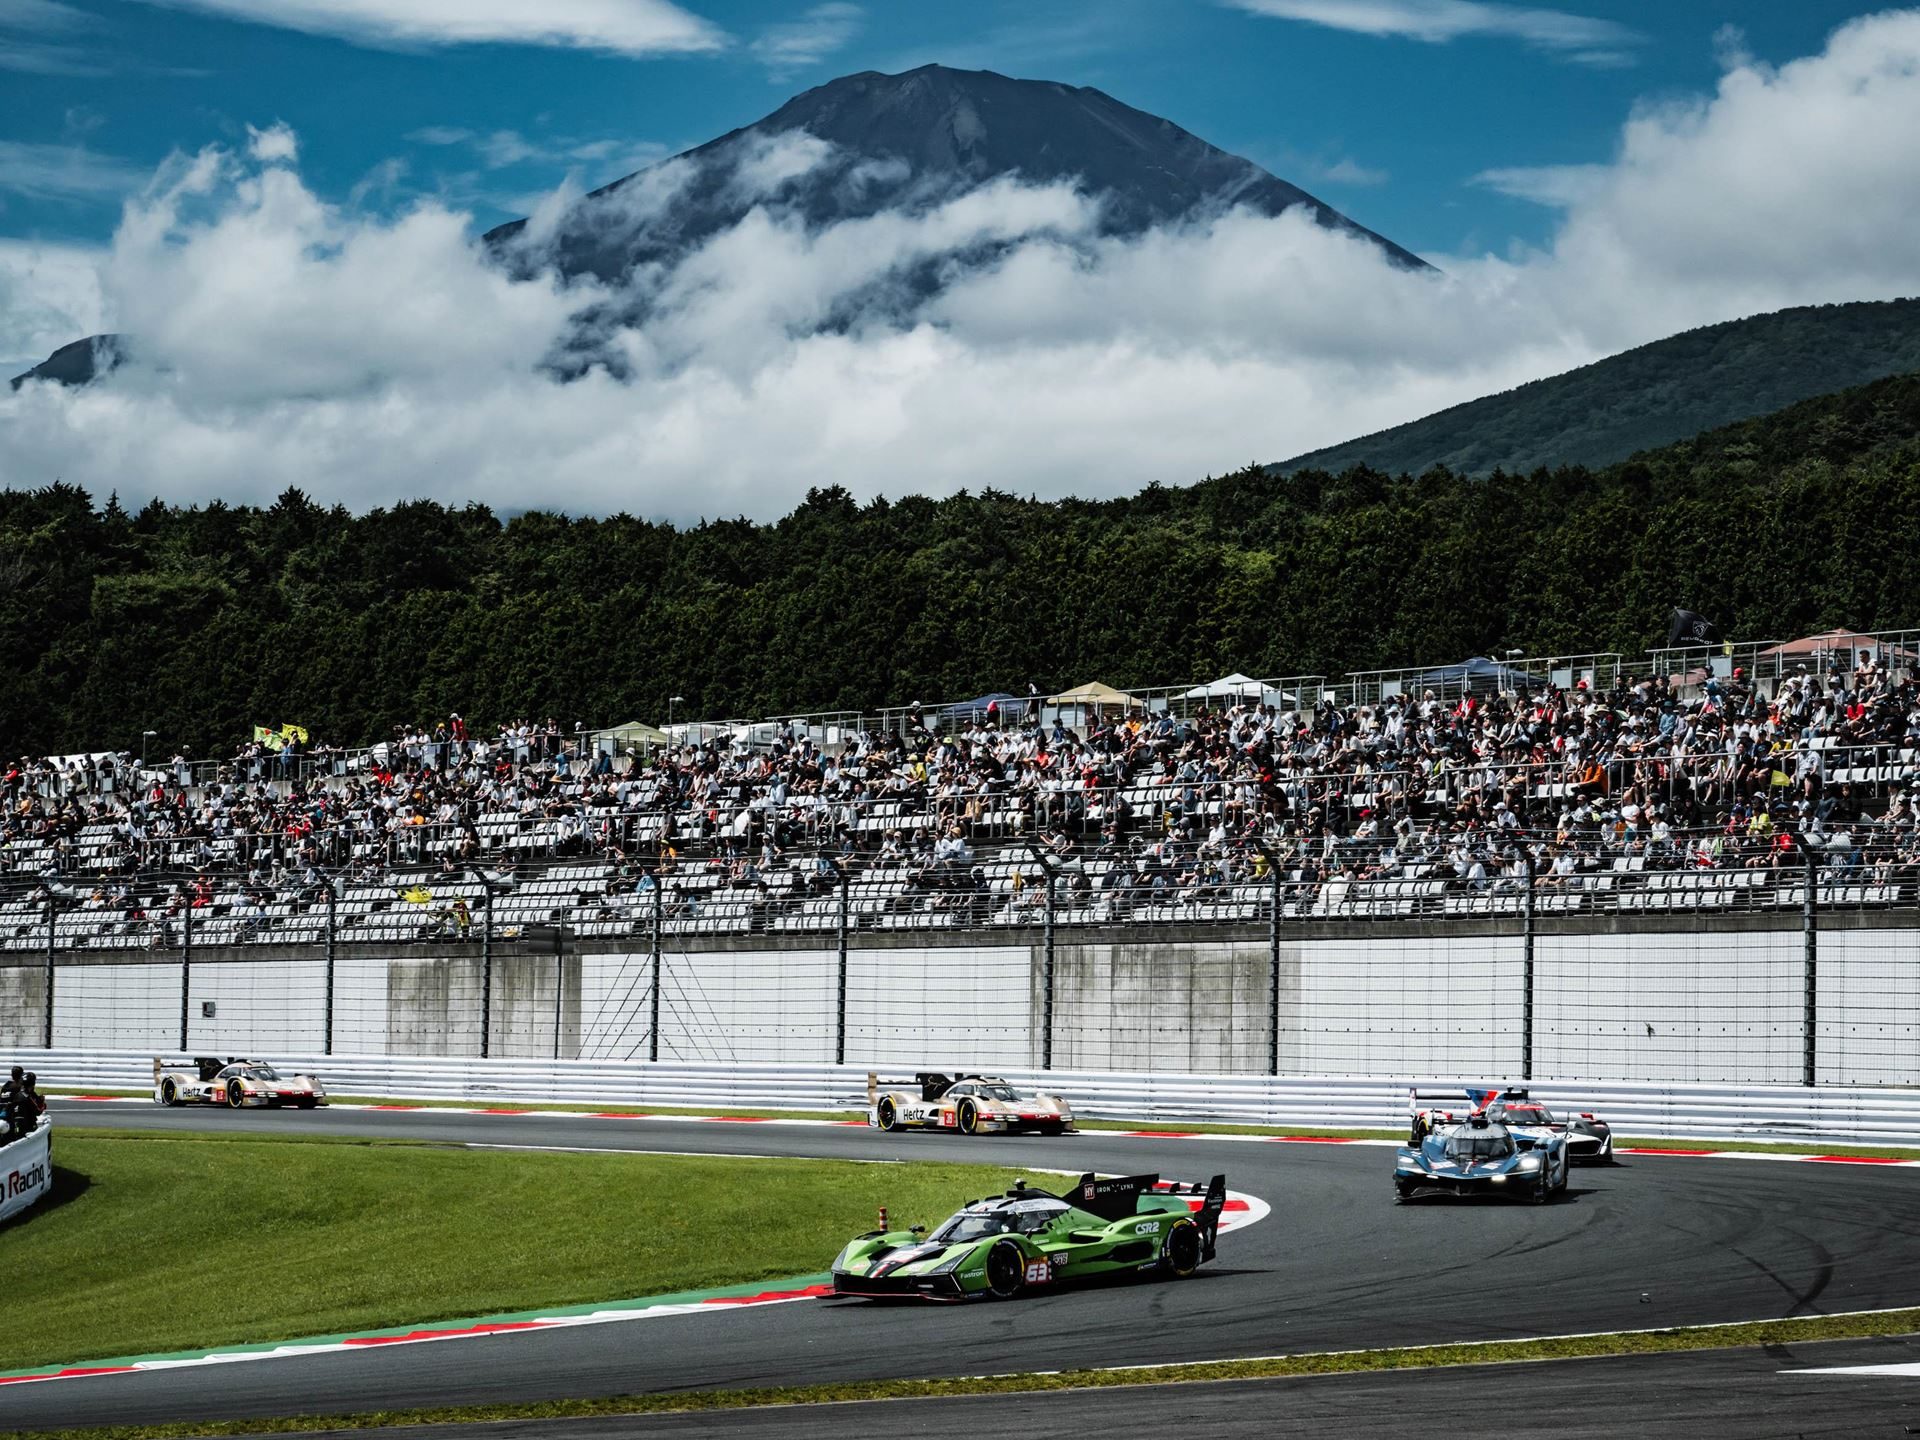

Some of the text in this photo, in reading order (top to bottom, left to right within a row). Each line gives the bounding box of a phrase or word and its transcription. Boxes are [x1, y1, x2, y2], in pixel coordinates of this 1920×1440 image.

[182, 1087, 200, 1098] Hertz
[903, 1107, 924, 1121] Hertz
[8, 1163, 45, 1199] Racing
[1120, 1183, 1134, 1191] LYNX
[1135, 1221, 1160, 1235] CSR2
[1026, 1263, 1048, 1282] 63
